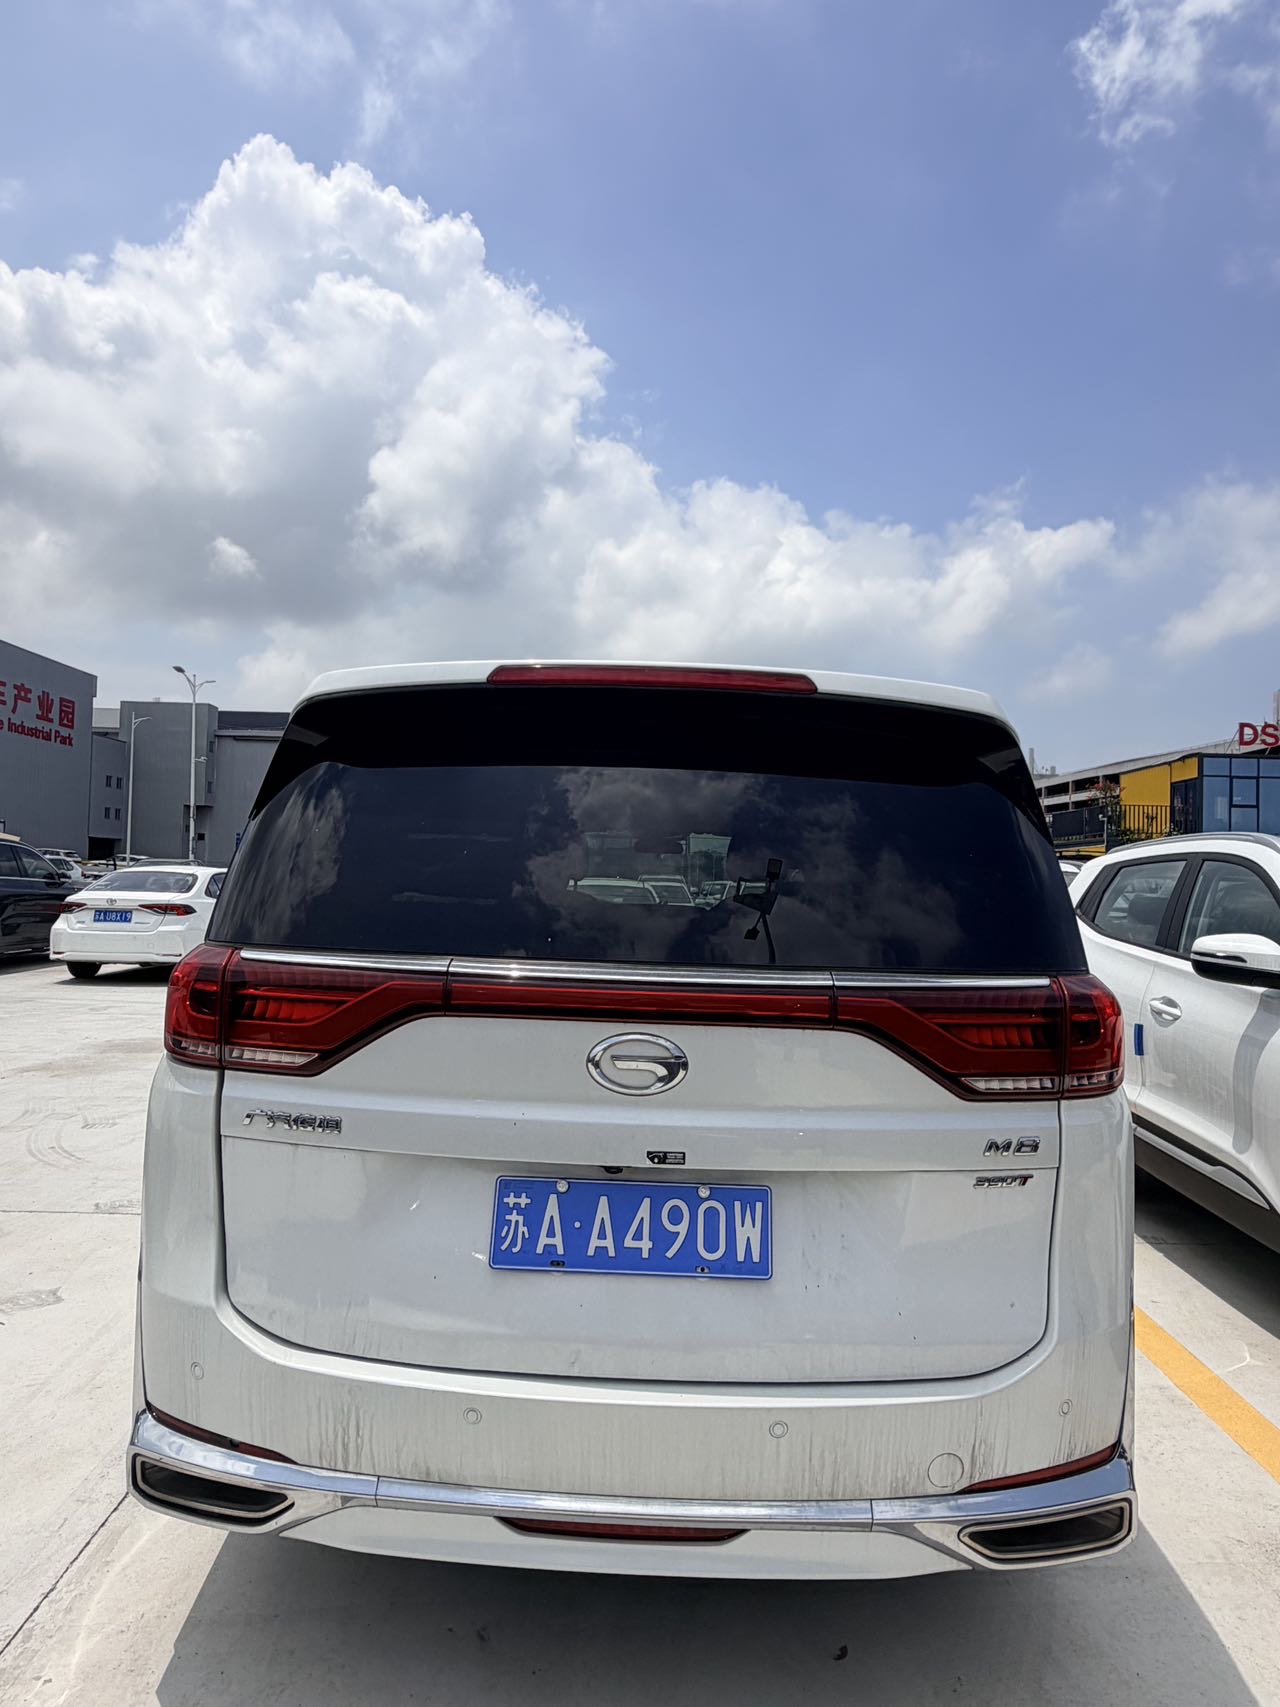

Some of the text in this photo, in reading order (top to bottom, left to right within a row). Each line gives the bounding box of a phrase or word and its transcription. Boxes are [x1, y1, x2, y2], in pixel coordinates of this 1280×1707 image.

[7, 717, 53, 742] Industrial
[54, 729, 74, 747] Park
[983, 1136, 1041, 1156] M8
